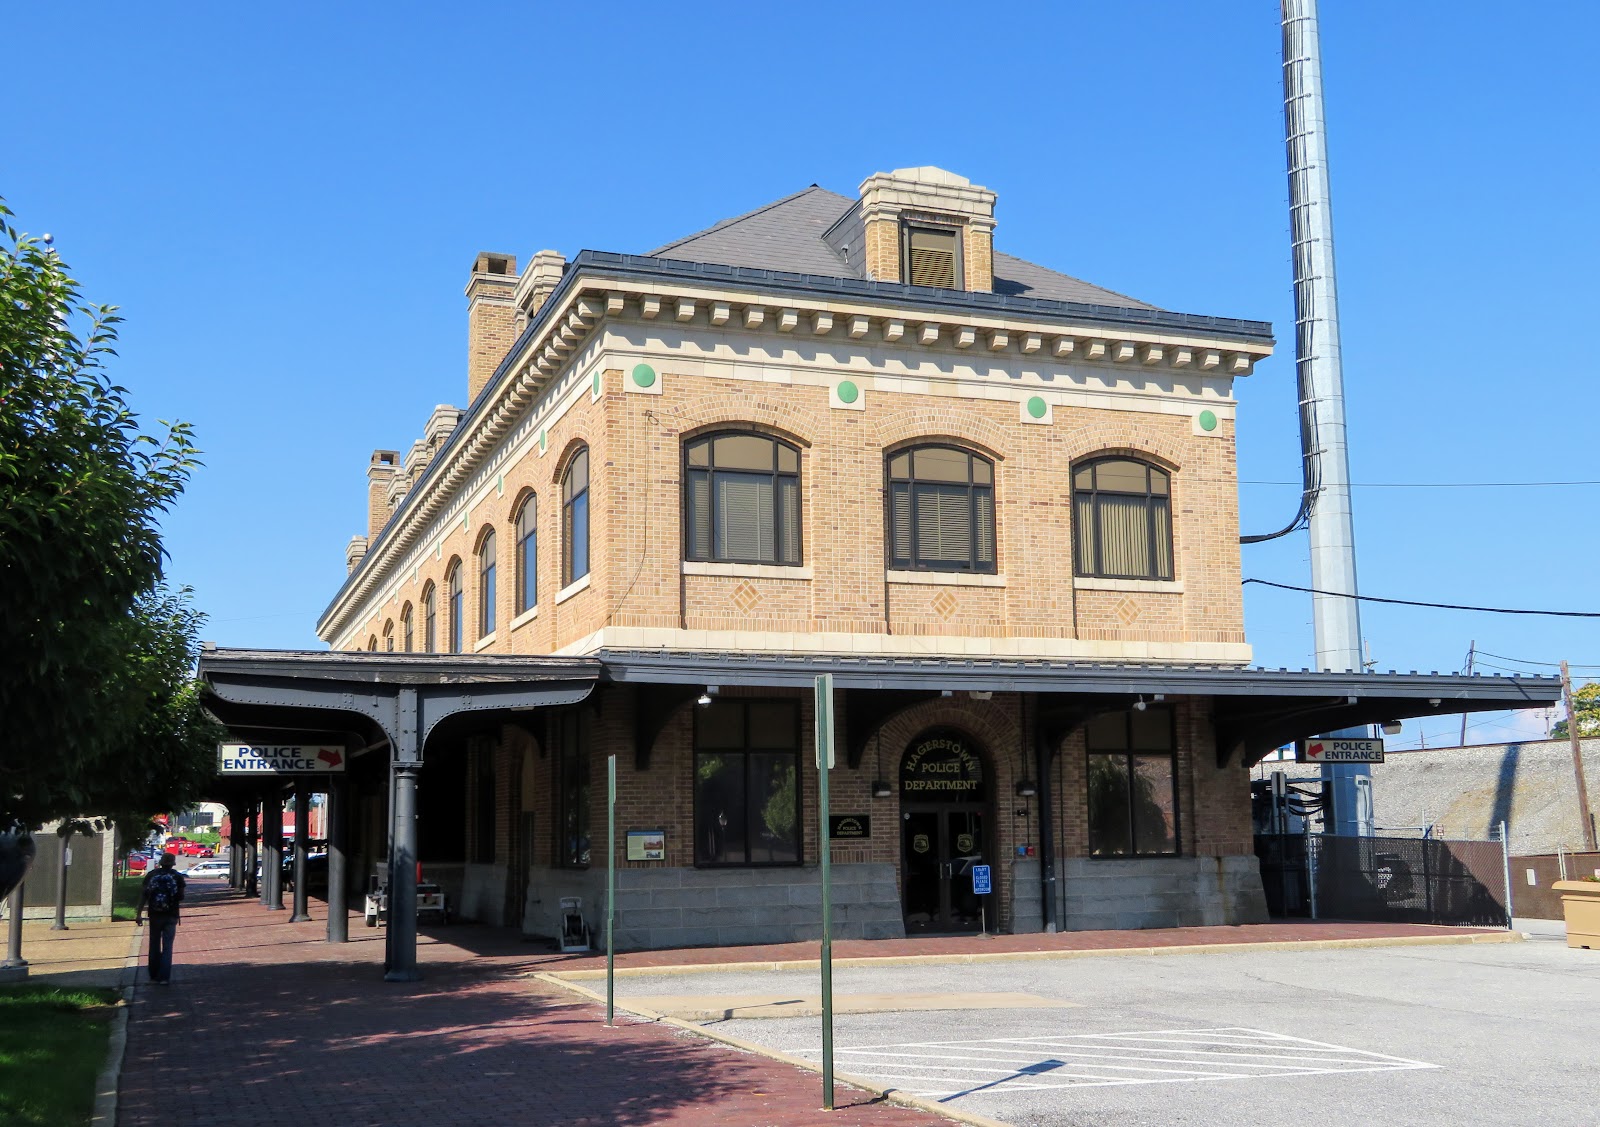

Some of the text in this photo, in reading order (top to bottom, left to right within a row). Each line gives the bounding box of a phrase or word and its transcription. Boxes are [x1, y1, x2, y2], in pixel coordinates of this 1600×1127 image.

[1333, 742, 1372, 751] POLICE
[238, 747, 302, 758] POLICE
[905, 740, 976, 772] HAGERSTOWN
[1325, 751, 1381, 760] ENTRANCE
[224, 759, 315, 769] ENTRANCE
[921, 763, 960, 773] POLICE
[904, 780, 977, 790] DEPARTMENT
